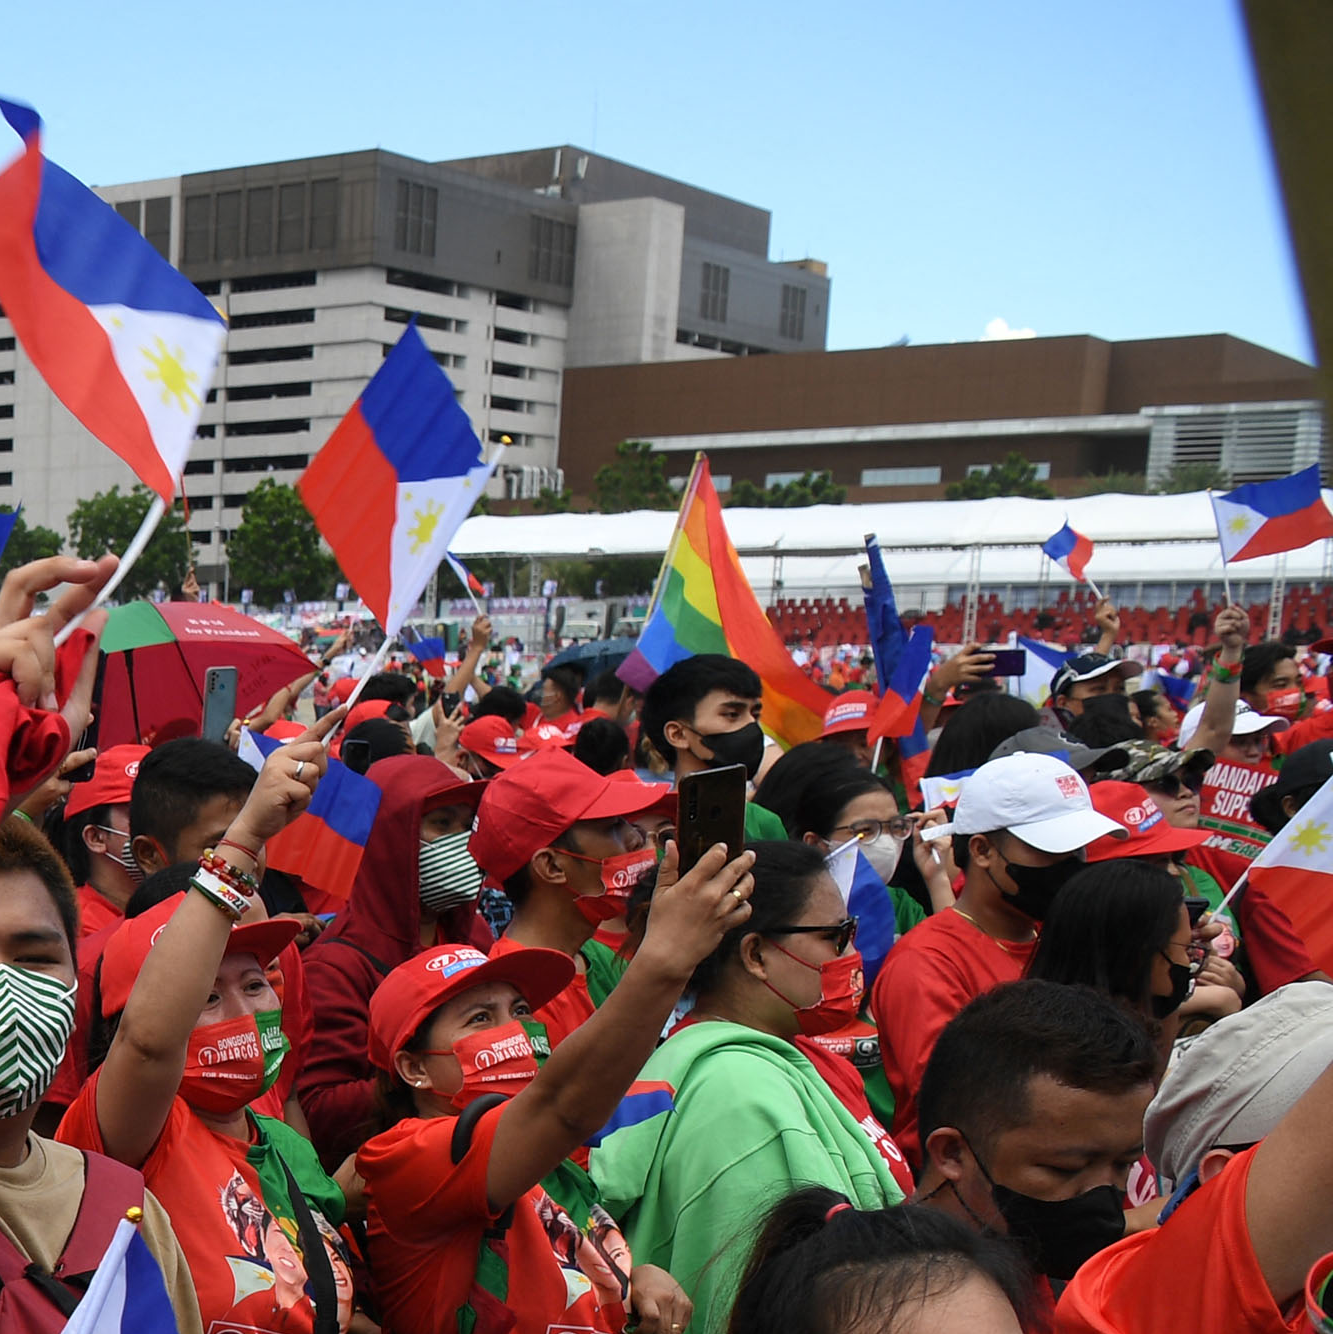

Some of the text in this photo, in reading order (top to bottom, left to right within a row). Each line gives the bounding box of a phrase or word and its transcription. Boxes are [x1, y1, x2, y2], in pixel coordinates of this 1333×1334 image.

[217, 1031, 256, 1051] BONGBONG
[491, 1033, 526, 1052] BONGBONG
[220, 1043, 260, 1062] MARCOS
[495, 1042, 533, 1062] MARCOS
[202, 1071, 217, 1079] FOR
